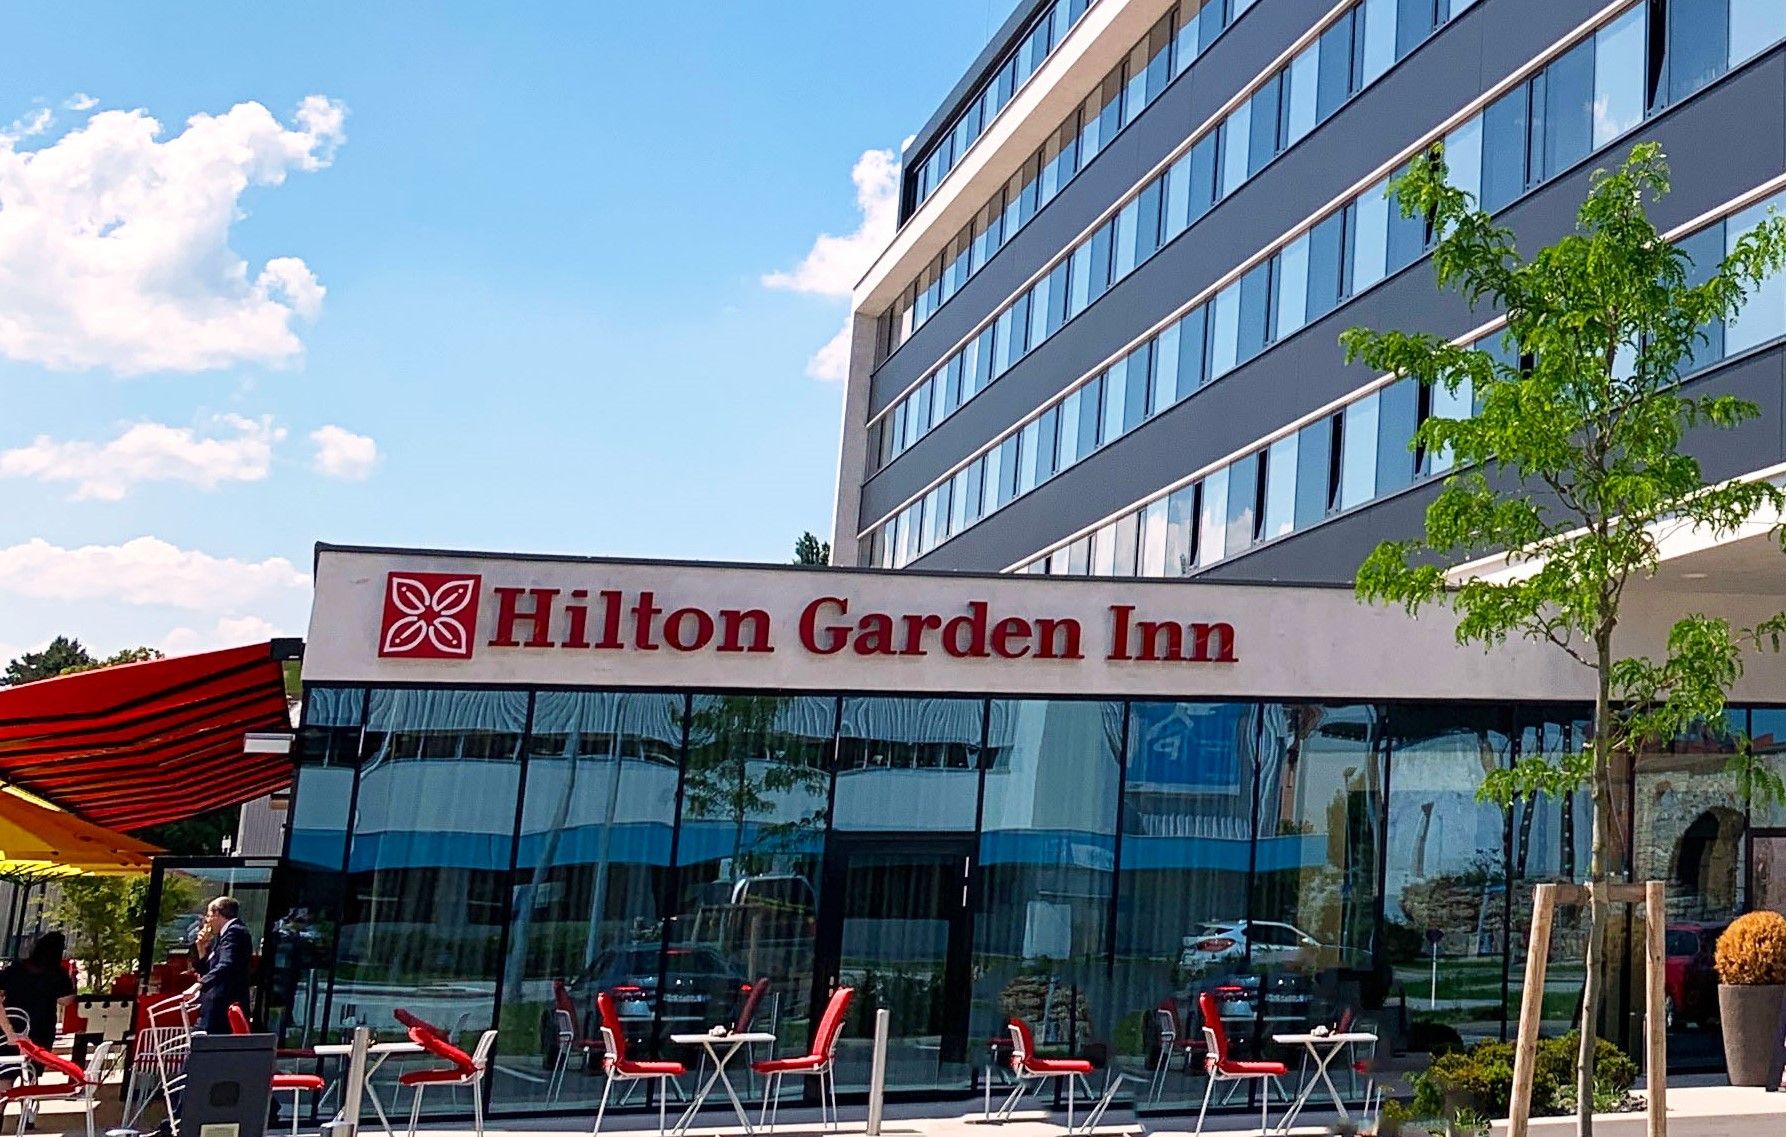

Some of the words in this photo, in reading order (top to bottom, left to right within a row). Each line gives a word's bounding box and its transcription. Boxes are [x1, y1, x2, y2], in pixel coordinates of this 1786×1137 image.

[488, 587, 775, 652] Hilton
[799, 596, 1085, 660] Garden
[1107, 605, 1239, 663] Inn
